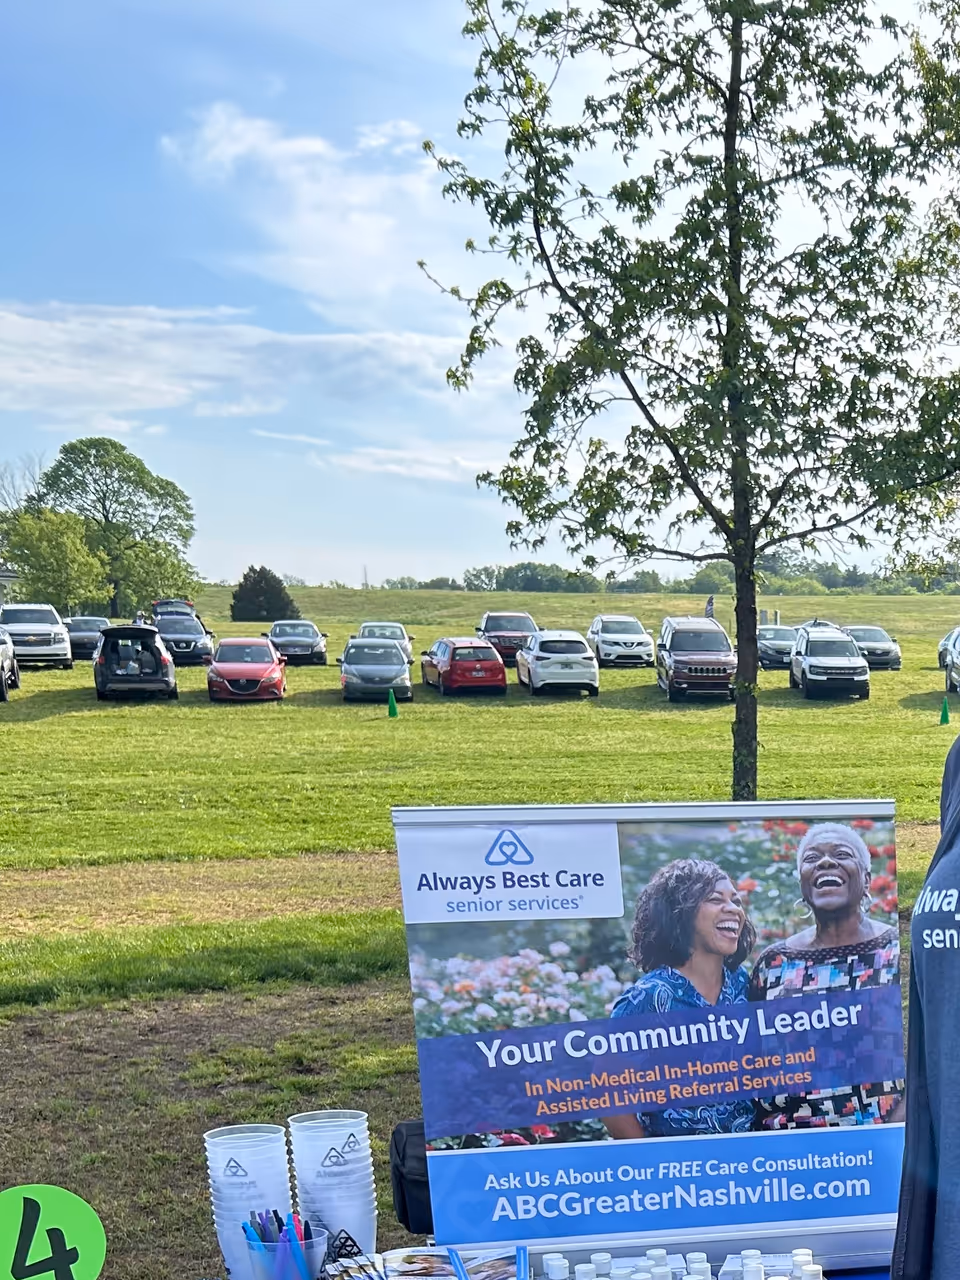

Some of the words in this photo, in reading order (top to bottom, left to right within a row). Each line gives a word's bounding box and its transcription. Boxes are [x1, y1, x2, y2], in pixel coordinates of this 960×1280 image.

[416, 870, 496, 895] Always
[502, 871, 550, 890] Best
[555, 869, 604, 887] Care
[446, 898, 503, 914] senior
[476, 1037, 556, 1068] Your
[564, 1014, 750, 1058] Community
[758, 1001, 862, 1037] Leader
[525, 1080, 543, 1097] In
[546, 1066, 660, 1095] Non-Medical
[664, 1058, 738, 1079] In-Home
[742, 1053, 780, 1071] Care
[784, 1047, 816, 1066] and
[536, 1094, 611, 1117] Assisted
[614, 1087, 667, 1110] Living
[670, 1076, 740, 1099] Referral
[743, 1068, 812, 1092] Services
[484, 1172, 521, 1192] Ask
[524, 1171, 551, 1188] Us
[554, 1166, 614, 1186] About
[618, 1165, 655, 1182] Our
[658, 1161, 702, 1180] FREE
[705, 1158, 749, 1176] Care
[752, 1149, 874, 1173] Consultation!
[492, 1173, 871, 1222] ABCGreaterNashville.com
